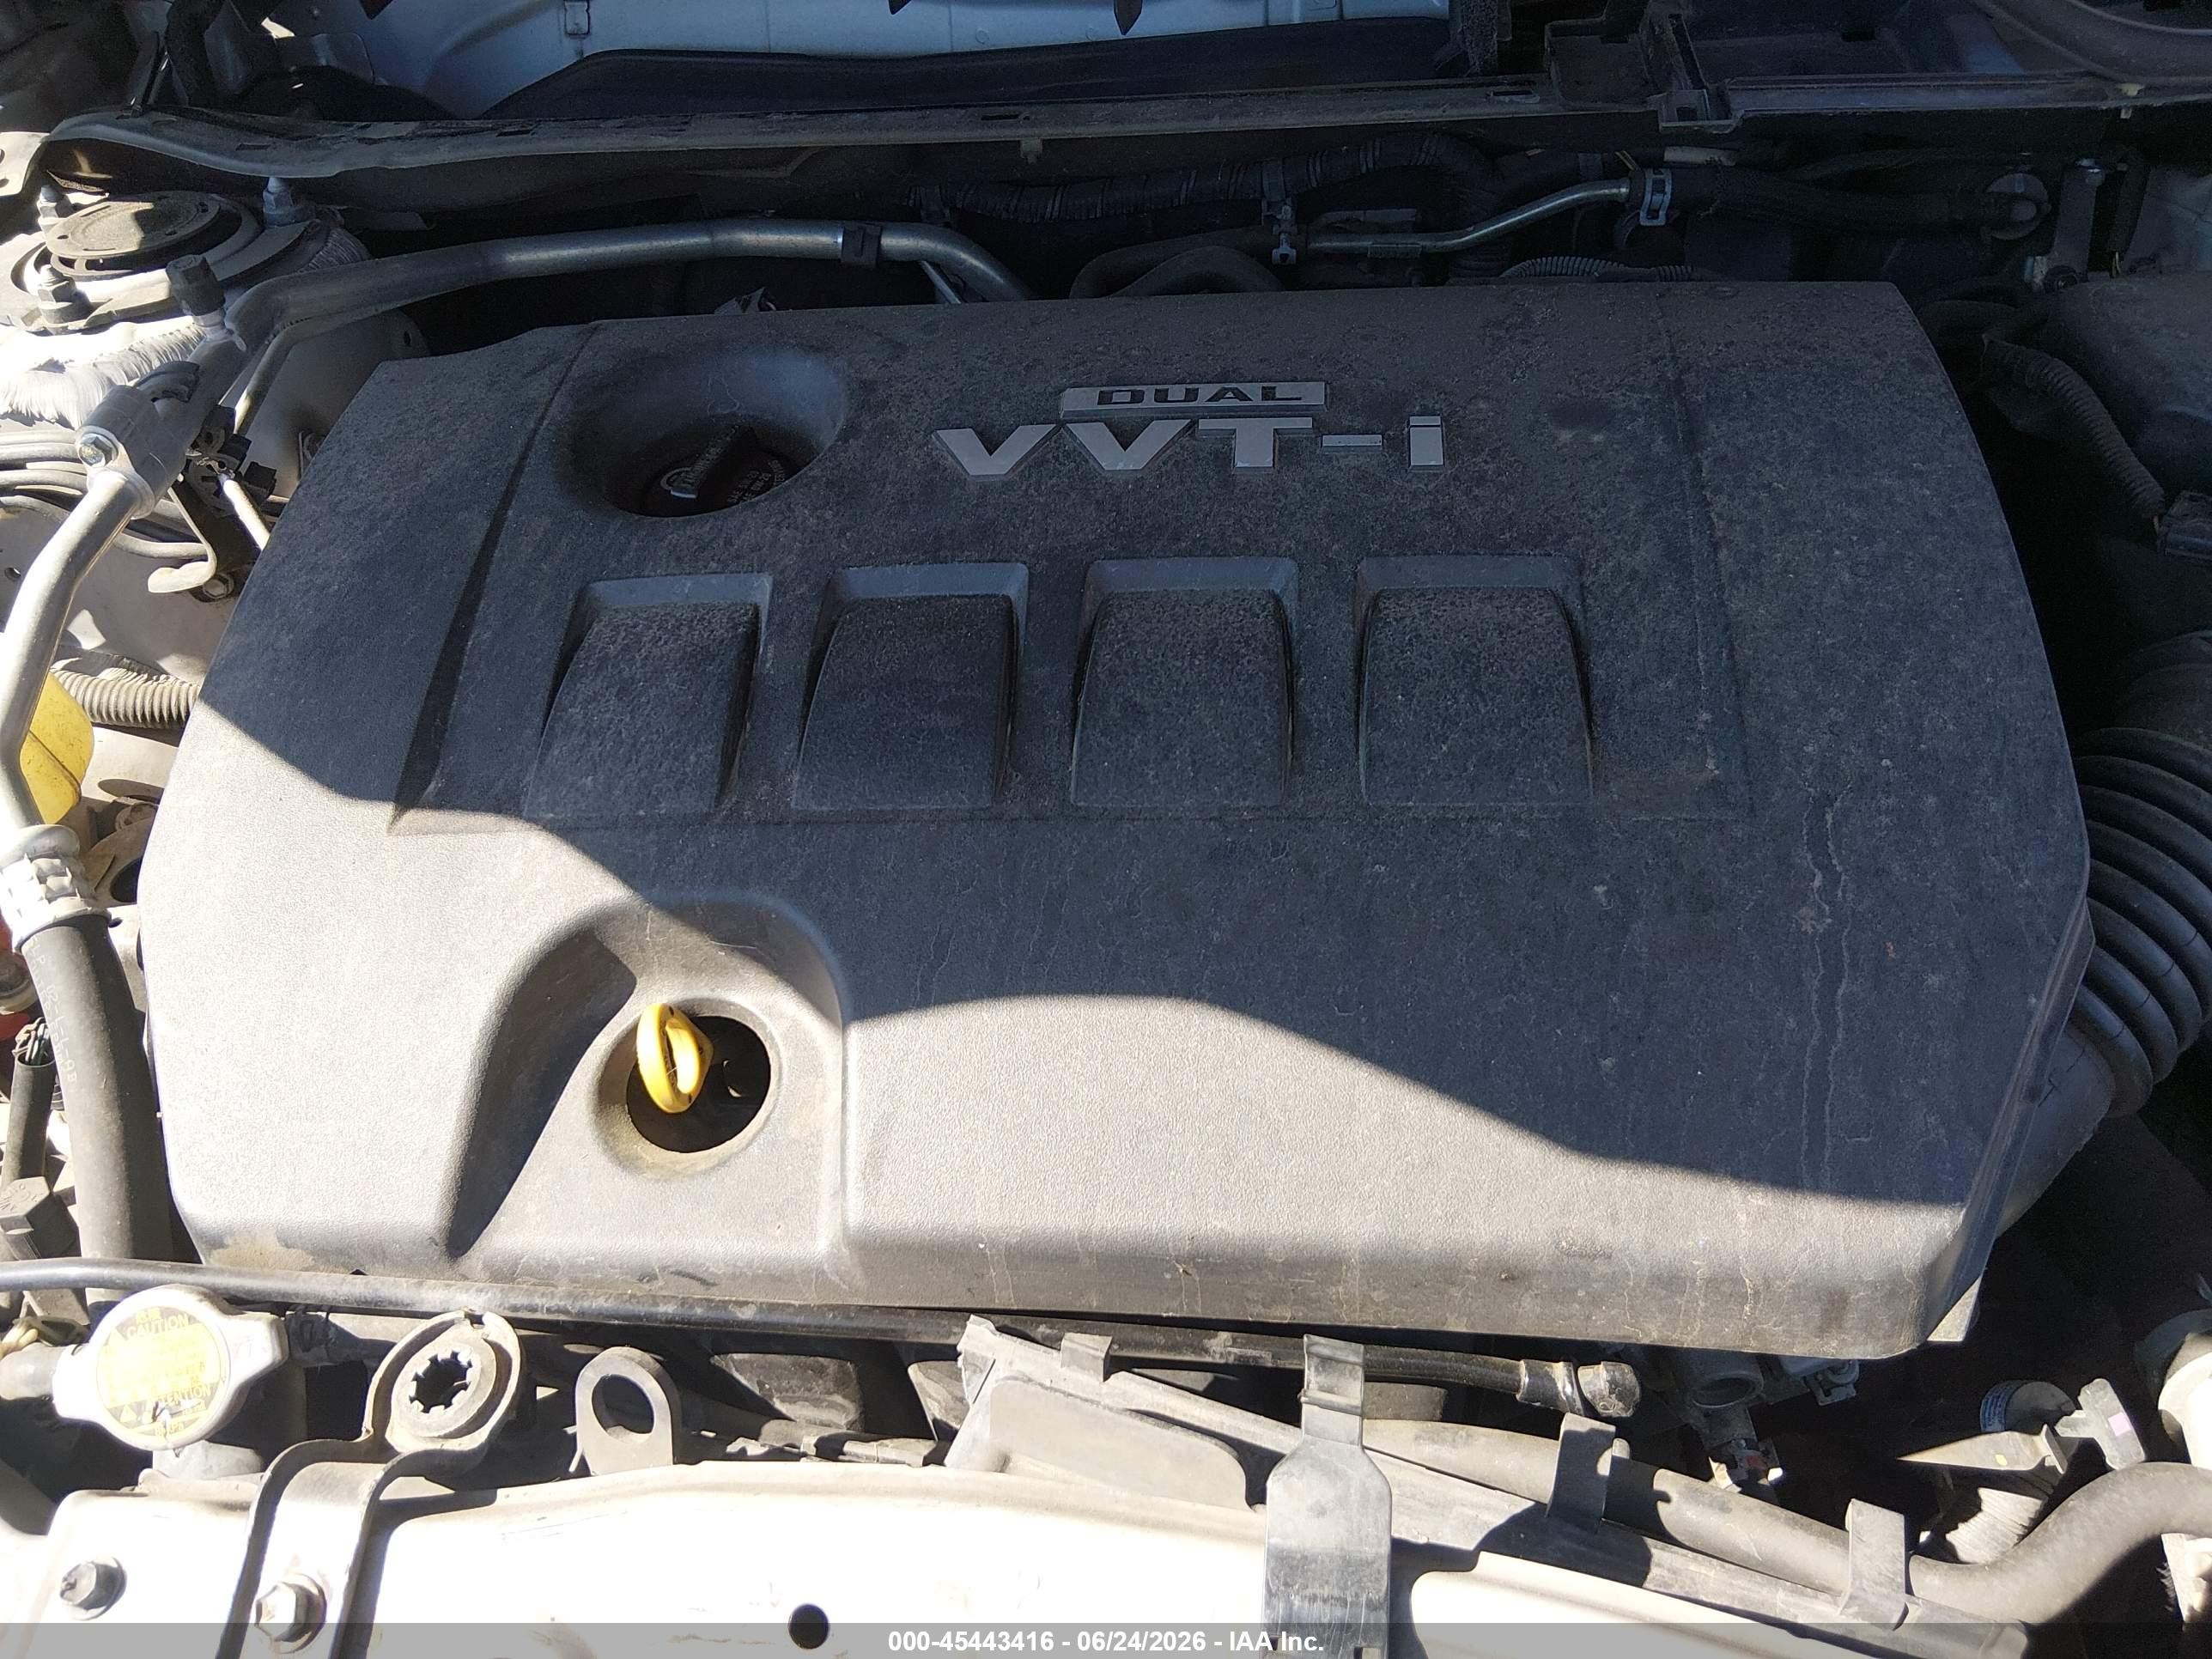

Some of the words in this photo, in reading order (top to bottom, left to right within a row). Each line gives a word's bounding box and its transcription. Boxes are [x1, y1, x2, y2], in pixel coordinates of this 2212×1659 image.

[1097, 386, 1304, 406] DUAL
[933, 416, 1445, 477] VVT-i
[126, 1311, 190, 1337] CAUTION
[143, 1383, 211, 1411] TENTION
